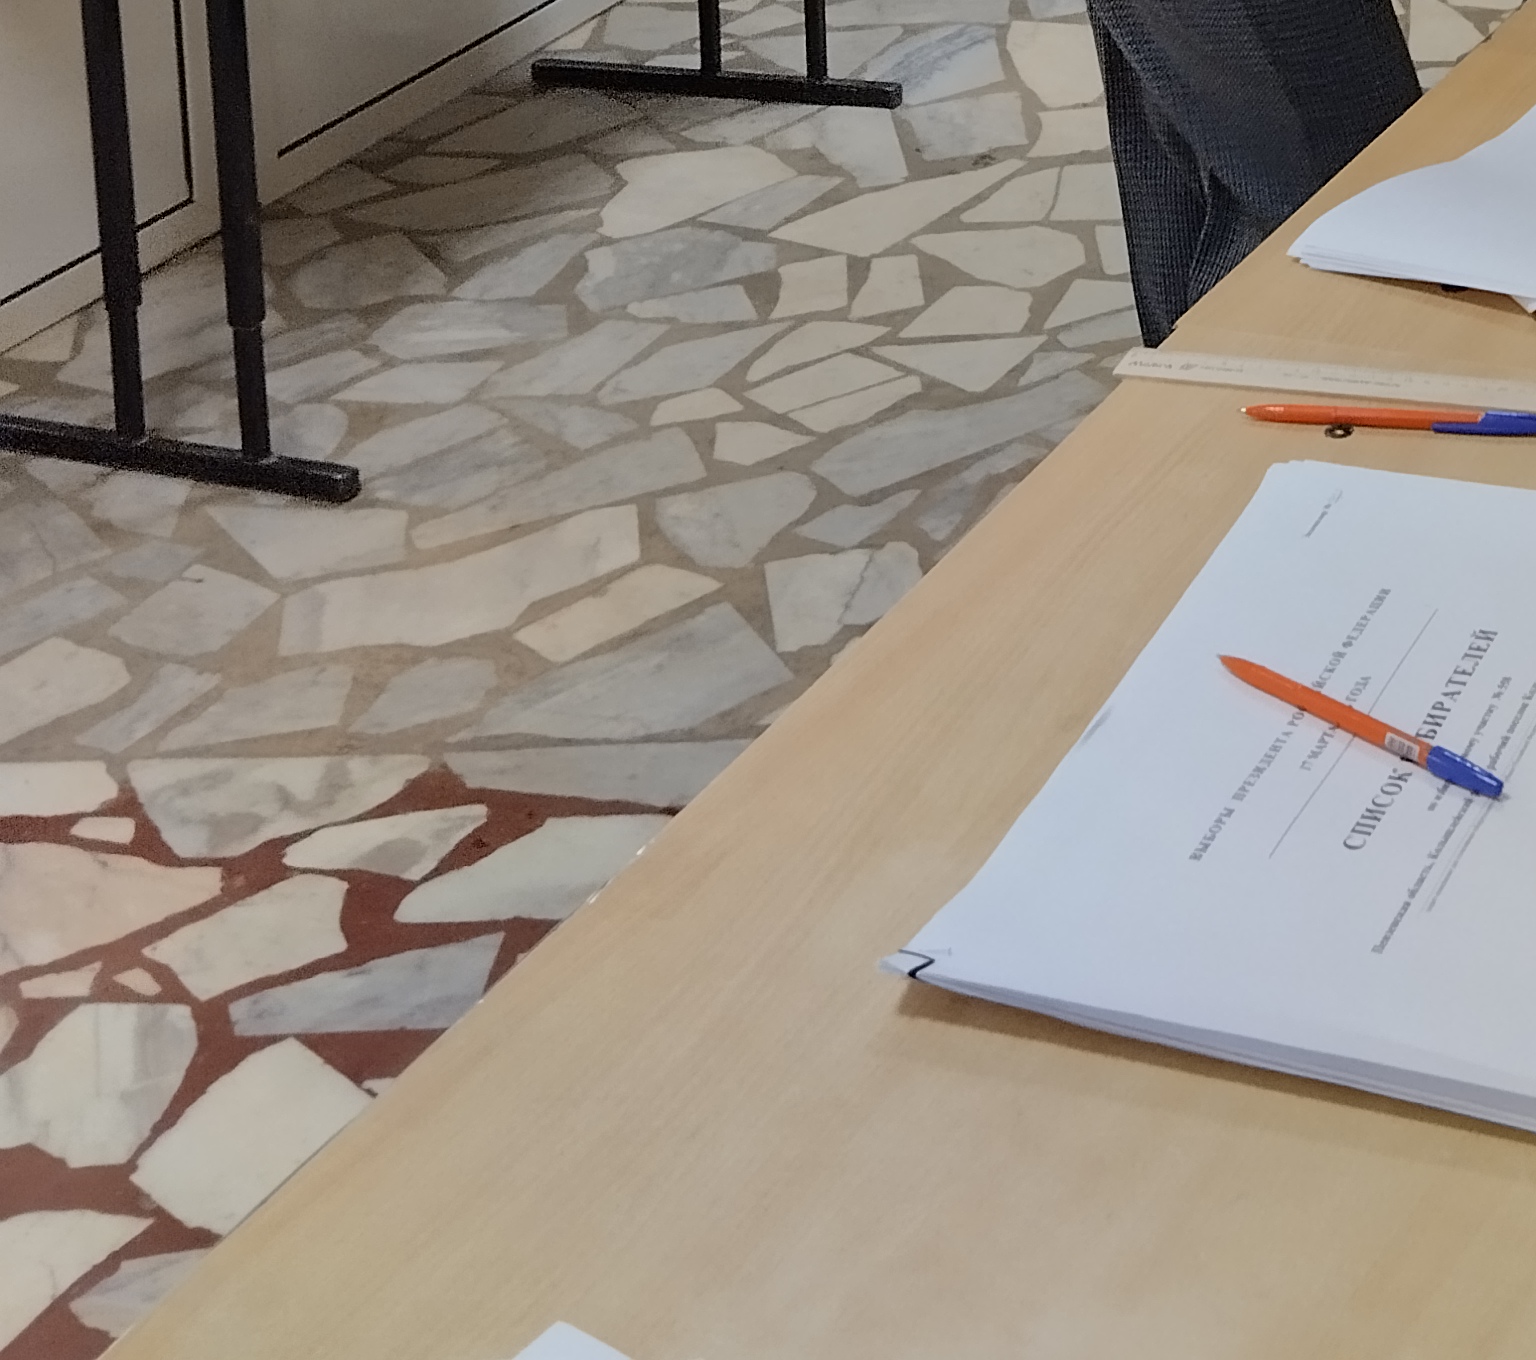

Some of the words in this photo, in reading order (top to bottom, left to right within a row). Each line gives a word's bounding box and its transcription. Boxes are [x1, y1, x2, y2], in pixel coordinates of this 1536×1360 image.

[1188, 806, 1235, 861] ВЫБОРЫ
[1231, 730, 1293, 802] ПРЕЗИДЕНТА
[1342, 587, 1391, 650] ФЕДЕРАЦИИ
[1342, 769, 1413, 851] СПИСОК
[1415, 628, 1498, 741] БИРАТЕЛЕЙ
